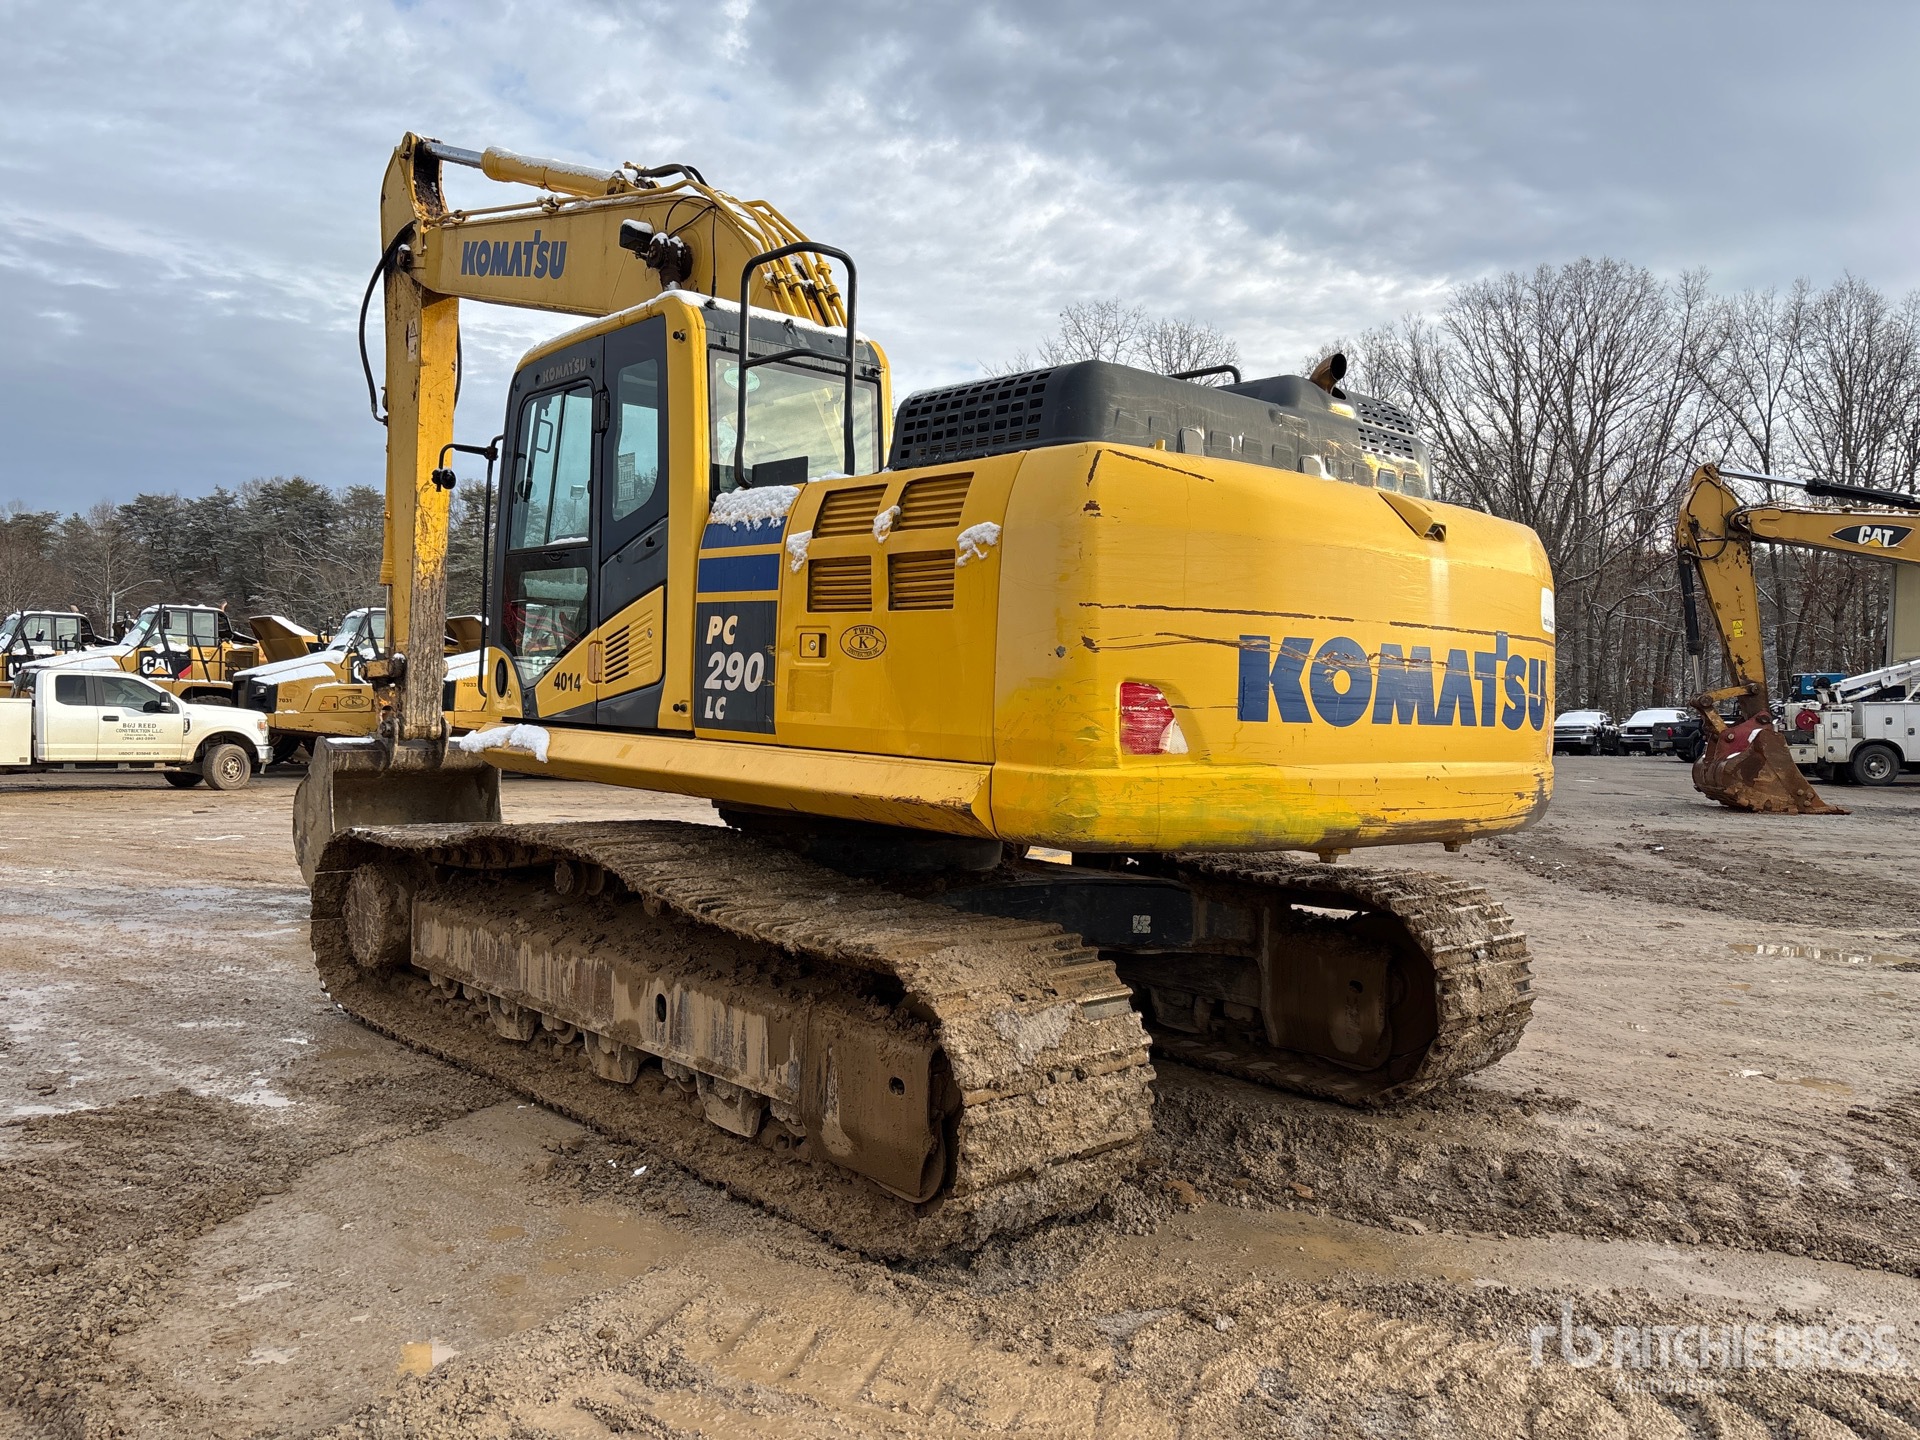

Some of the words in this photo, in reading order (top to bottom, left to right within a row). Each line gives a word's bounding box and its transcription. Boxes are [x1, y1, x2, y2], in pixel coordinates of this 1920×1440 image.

[461, 230, 567, 279] KOMATSU
[543, 357, 587, 383] KOMATSU
[1858, 526, 1894, 548] CAT
[706, 615, 738, 645] PC
[859, 636, 868, 649] K
[142, 656, 176, 675] CA
[704, 651, 765, 693] 290
[554, 672, 581, 692] 4014
[1237, 630, 1547, 731] KOMATSU
[704, 696, 727, 720] LC
